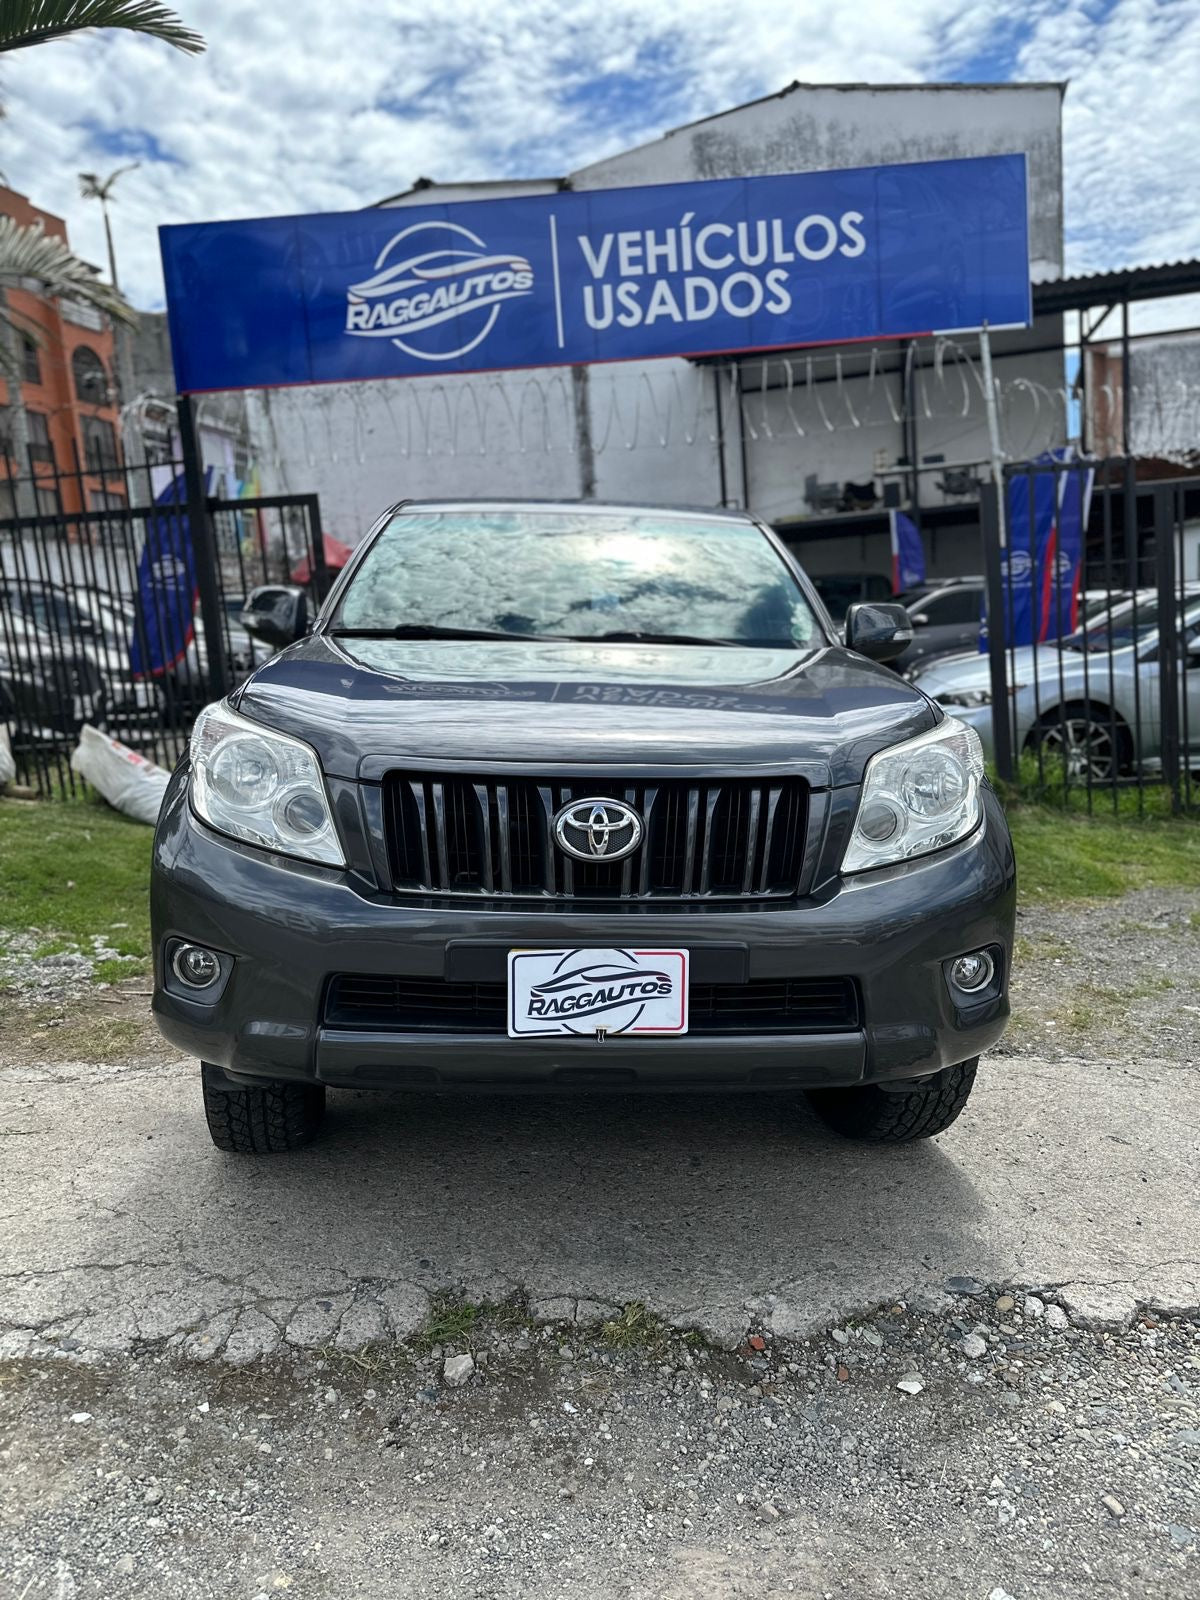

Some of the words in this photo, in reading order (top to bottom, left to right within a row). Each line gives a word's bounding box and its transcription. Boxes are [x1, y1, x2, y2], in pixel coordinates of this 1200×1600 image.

[578, 211, 867, 279] VEHÍCULOS
[346, 271, 534, 330] RAGGAUTOS
[583, 268, 792, 330] USADOS
[527, 982, 673, 1016] RAGGAUTOS
